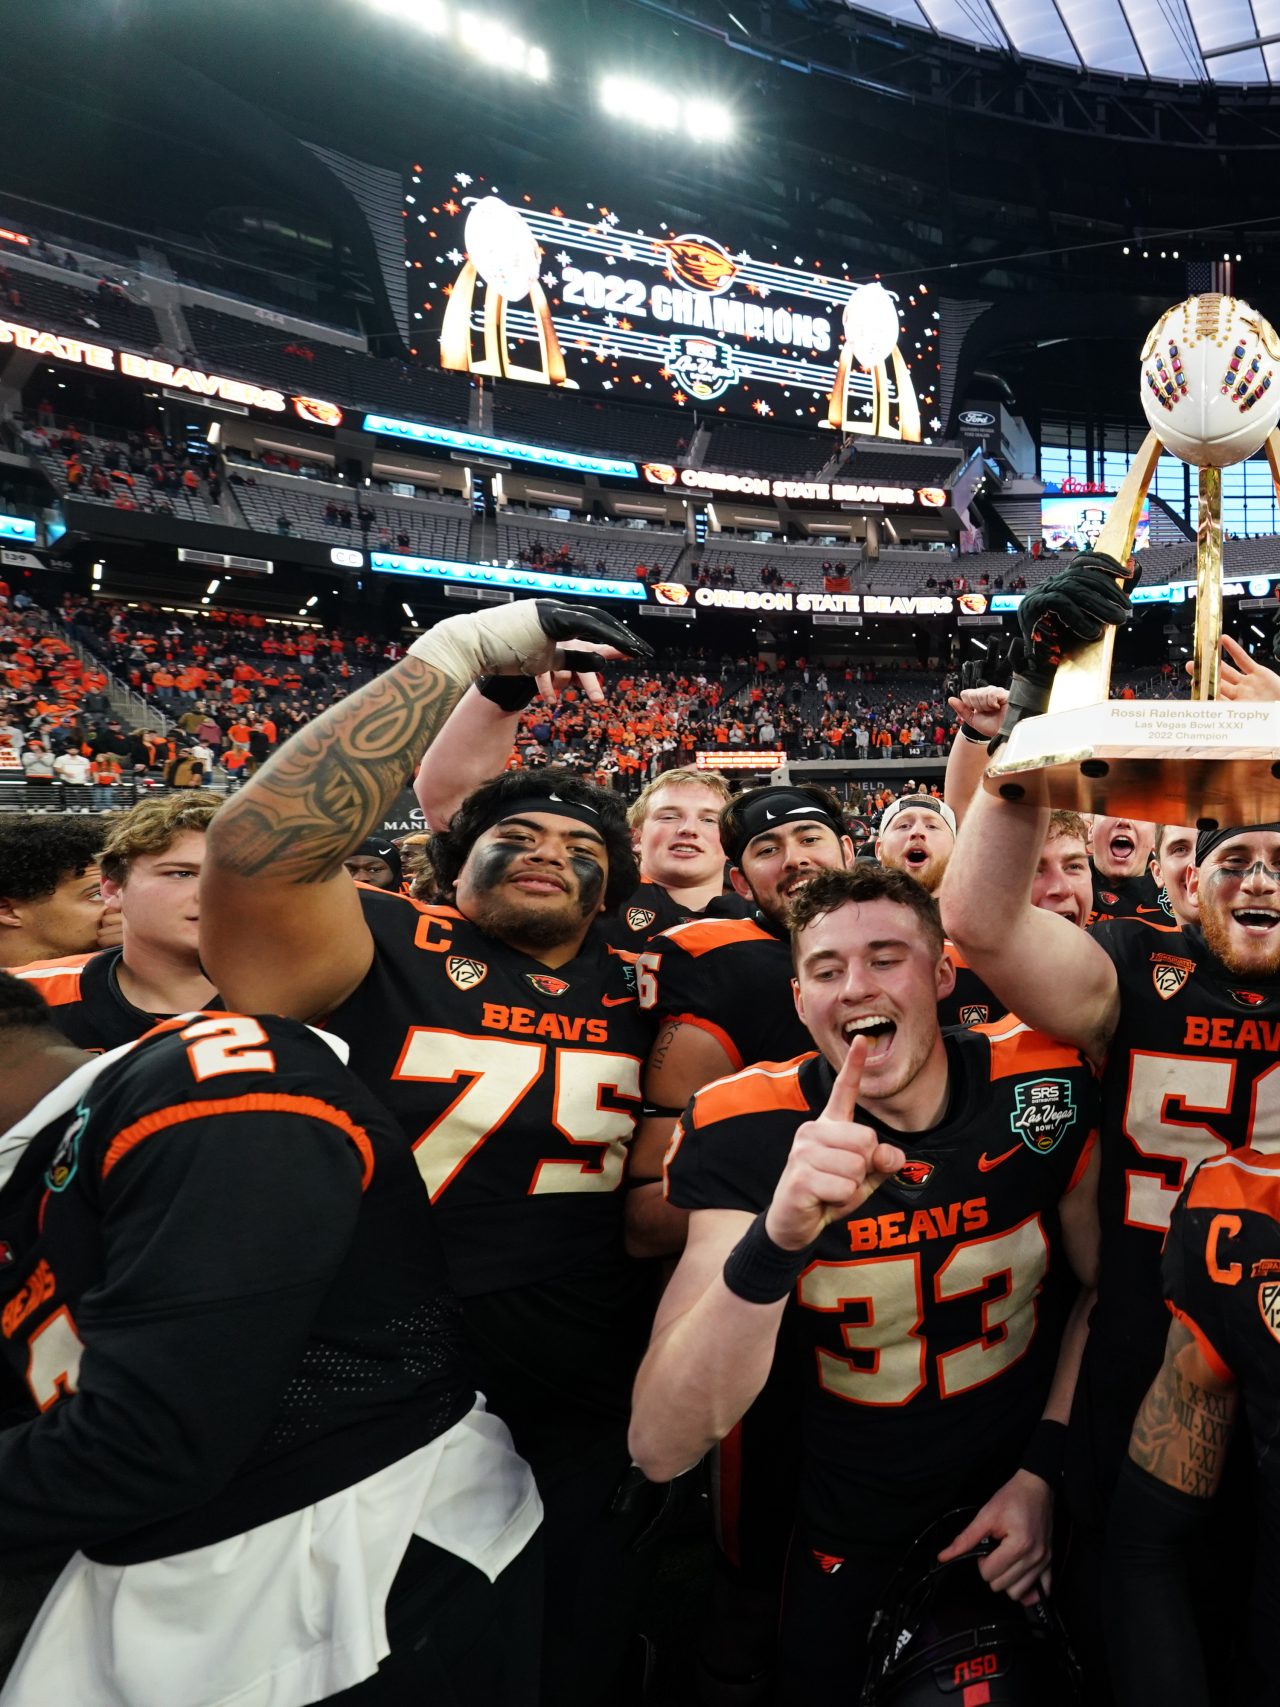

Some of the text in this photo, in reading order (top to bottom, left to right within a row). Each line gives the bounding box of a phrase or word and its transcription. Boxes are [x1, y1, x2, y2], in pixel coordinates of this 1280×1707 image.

[562, 267, 831, 351] 2022 CHAMPIONS
[120, 352, 287, 412] BEAVERS
[965, 412, 989, 424] Ford
[680, 469, 915, 504] OREGON STATE BEAVERS
[1062, 477, 1106, 494] Coors
[695, 587, 953, 615] OREGON STATE BEAVERS
[1111, 708, 1146, 718] Rossi
[1227, 709, 1270, 721] Trophy
[1134, 721, 1244, 731] Las Vegas Bowl XXXI
[1148, 731, 1228, 741] 2022 Champion
[857, 781, 885, 790] IELD
[414, 914, 453, 953] C
[455, 970, 475, 984] 12
[1160, 979, 1177, 991] 12
[482, 1002, 608, 1043] BEAVS
[179, 1014, 276, 1084] 2
[1030, 1086, 1059, 1100] SRS
[391, 1025, 643, 1207] 75
[1015, 1104, 1073, 1127] Las Vegas
[1035, 1124, 1055, 1132] BOWL
[847, 1196, 989, 1252] BEAVS
[1205, 1214, 1243, 1286] C
[798, 1211, 1050, 1407] 33
